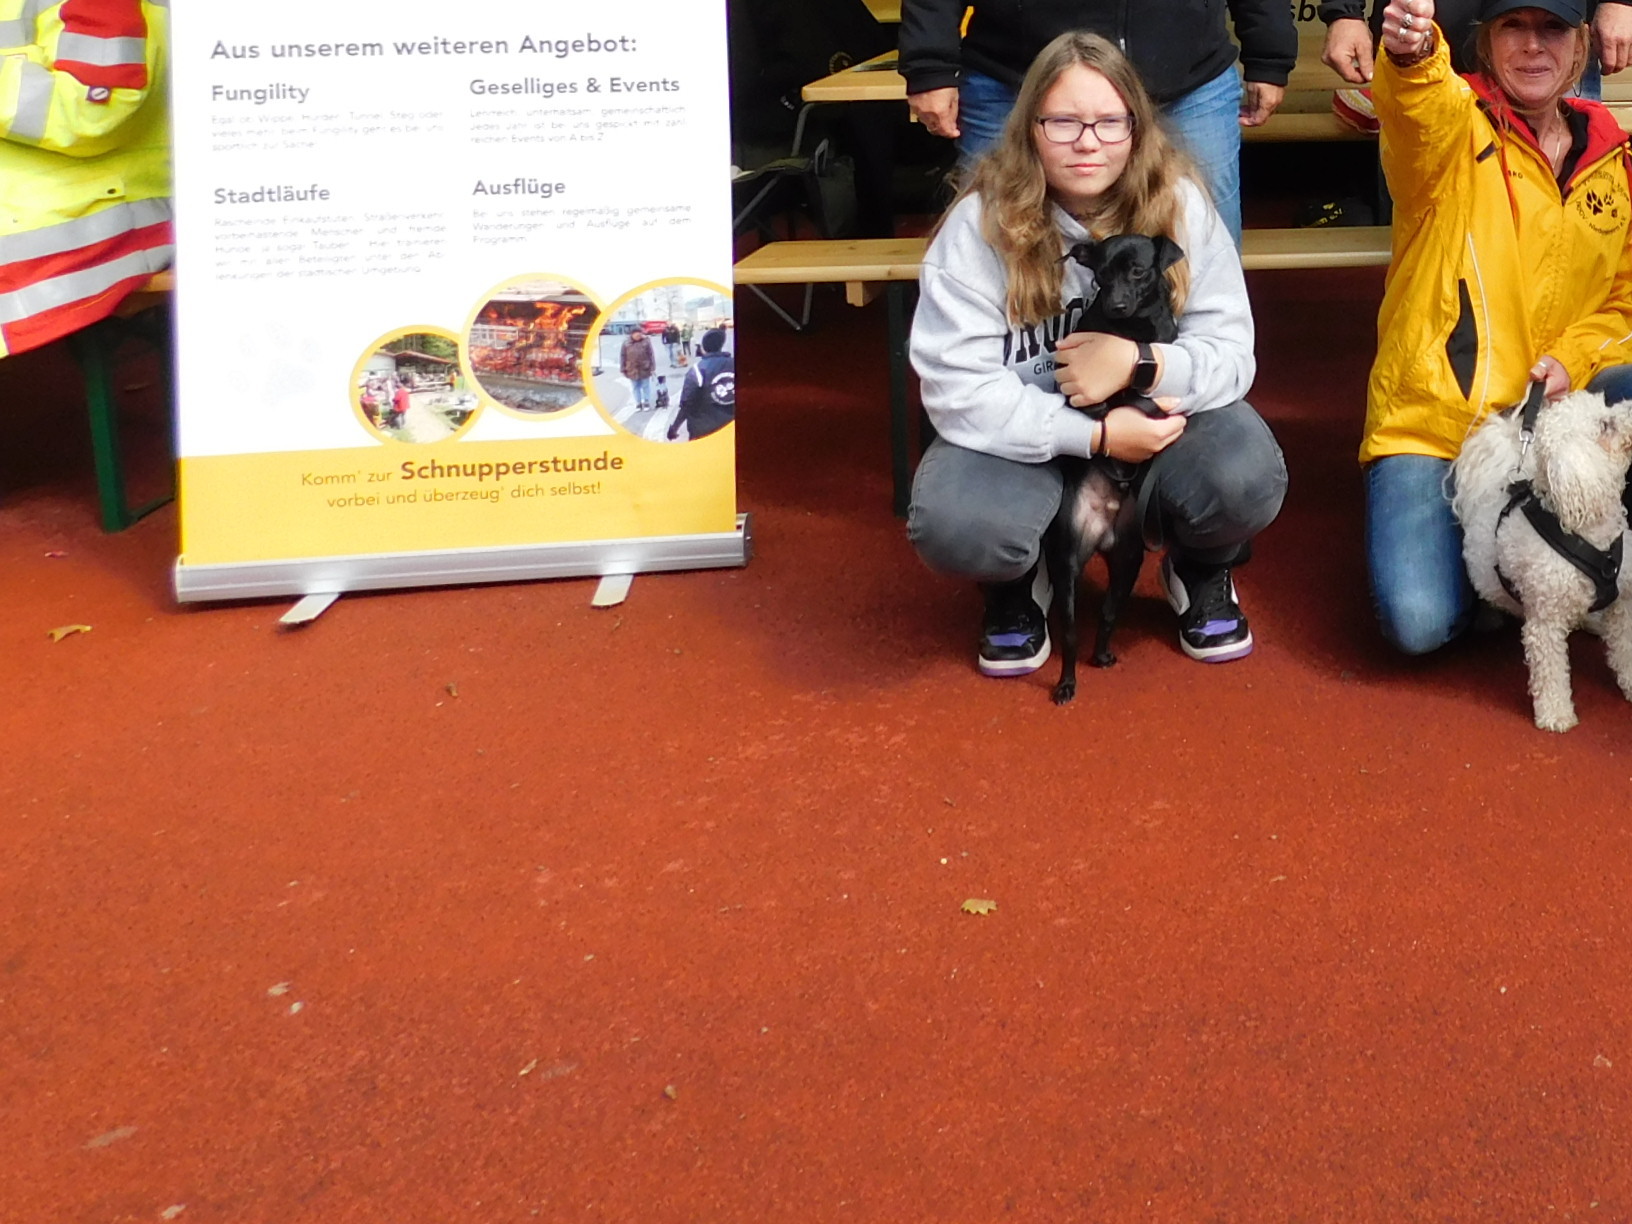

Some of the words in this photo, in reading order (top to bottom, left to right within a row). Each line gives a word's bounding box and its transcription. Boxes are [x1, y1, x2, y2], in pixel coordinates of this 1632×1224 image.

[210, 40, 261, 59] Aus
[271, 42, 384, 58] unserem
[393, 36, 509, 56] weiteren
[518, 33, 637, 59] Angebot:
[212, 82, 310, 105] Fungility
[469, 77, 578, 99] Geselliges
[586, 77, 602, 93] &
[609, 76, 680, 93] Events
[214, 183, 330, 204] Stadtläufe
[472, 178, 566, 198] Ausflüge
[301, 469, 361, 486] Komm'
[366, 470, 393, 484] zur
[400, 451, 624, 482] Schnupperstunde
[326, 489, 381, 508] vorbei
[386, 489, 418, 506] und
[423, 485, 505, 504] überzeug'
[510, 484, 545, 499] dich
[550, 481, 601, 497] selbst!
